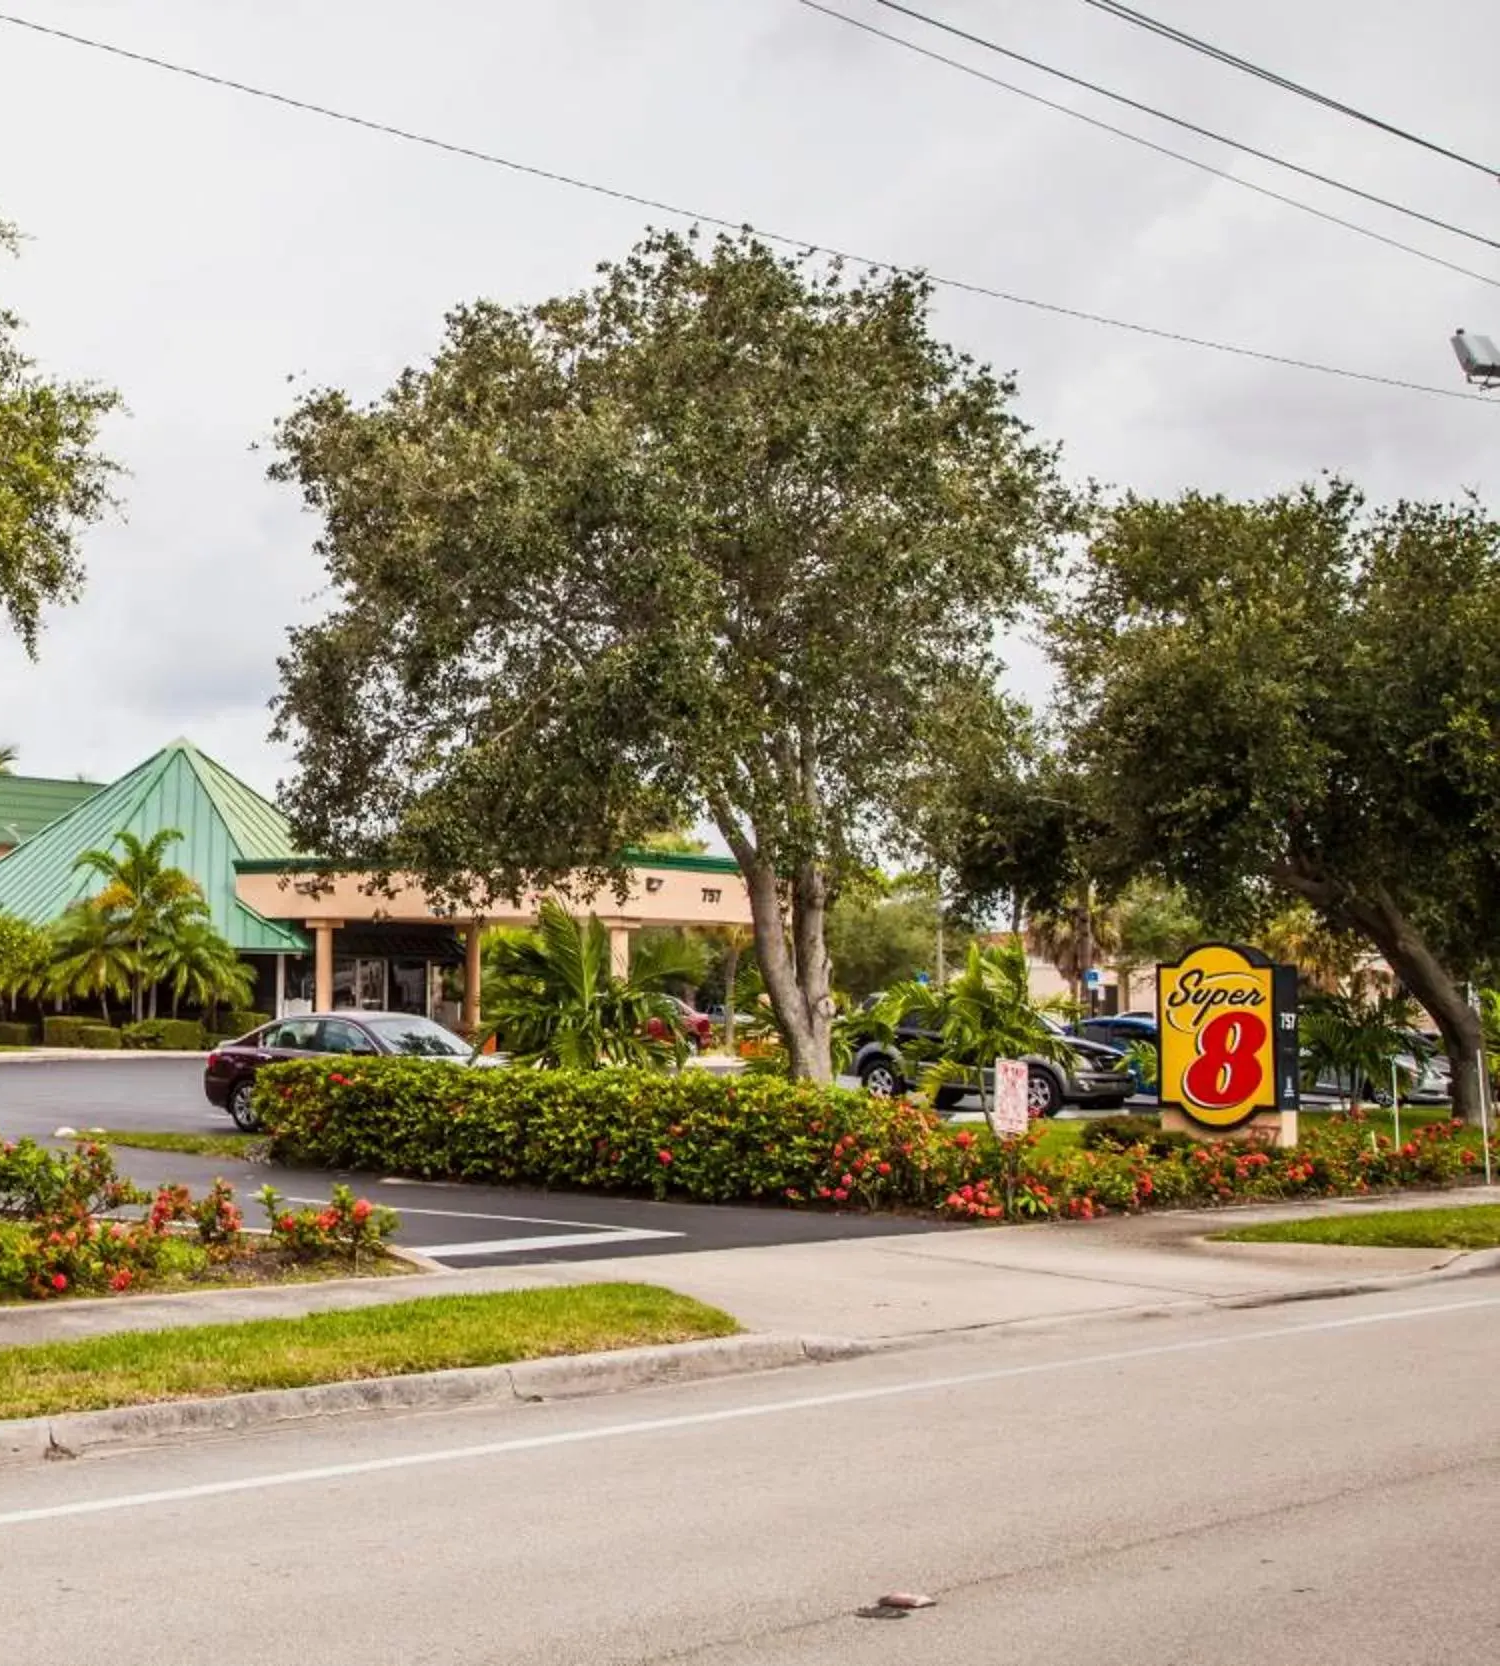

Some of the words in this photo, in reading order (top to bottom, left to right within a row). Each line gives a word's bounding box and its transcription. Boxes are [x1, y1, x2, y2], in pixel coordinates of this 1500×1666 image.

[701, 887, 722, 904] 757
[1167, 969, 1267, 1027] Super
[1280, 1012, 1296, 1030] 757
[1181, 1010, 1268, 1110] 8
